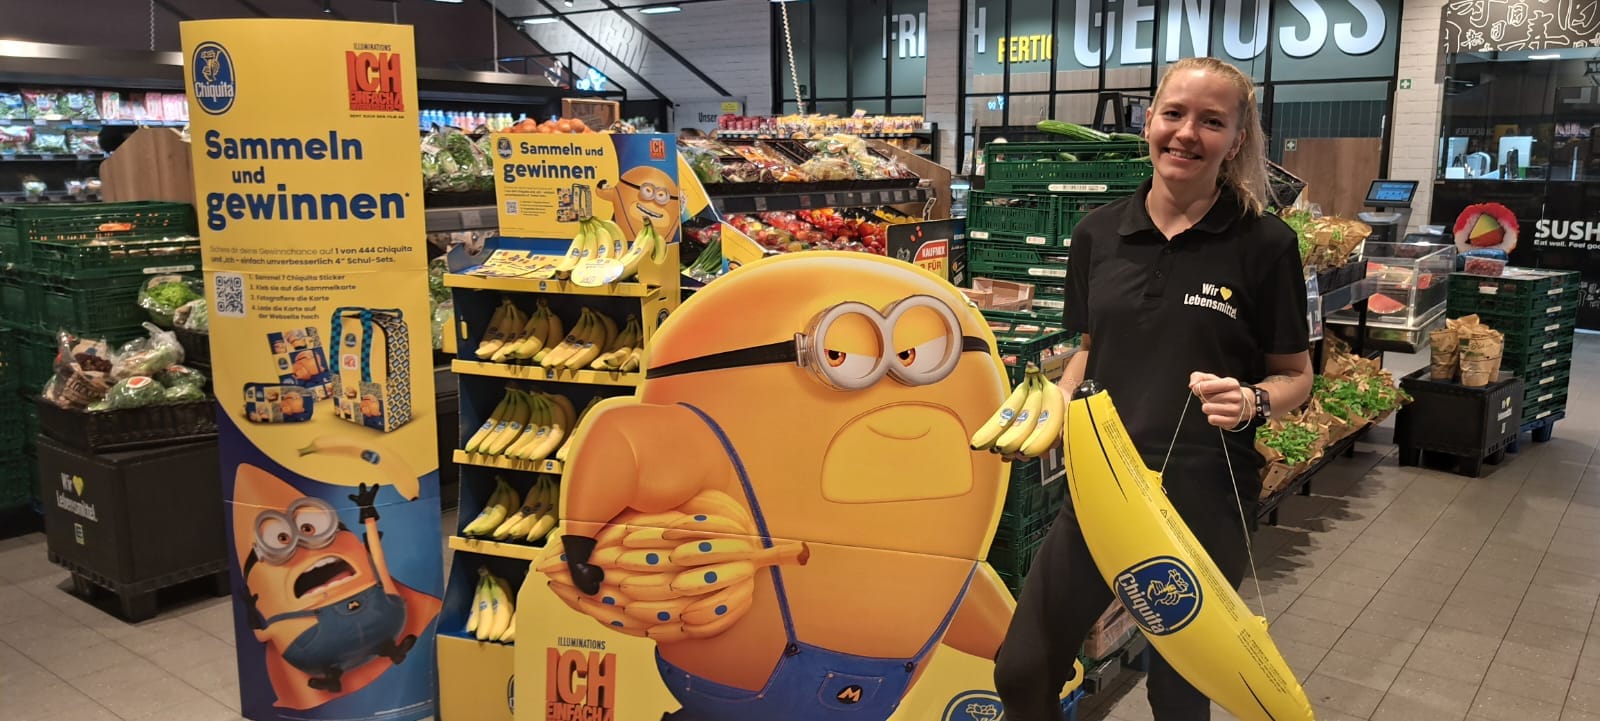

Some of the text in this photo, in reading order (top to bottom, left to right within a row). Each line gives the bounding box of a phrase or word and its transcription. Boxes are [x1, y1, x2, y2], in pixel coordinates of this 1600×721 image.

[345, 51, 402, 93] ICH
[195, 81, 234, 102] Chiquita
[698, 112, 717, 123] Unser
[205, 130, 363, 160] Sammeln
[520, 141, 582, 155] Sammeln
[585, 147, 603, 156] und
[232, 166, 265, 184] und
[319, 247, 334, 255] auf
[377, 245, 413, 254] Chiquita
[928, 260, 942, 271] FÜR
[1202, 283, 1219, 296] Wir
[1118, 573, 1165, 633] Chiquita
[557, 636, 606, 650] ILLUMINATIONS
[546, 647, 617, 709] ICH
